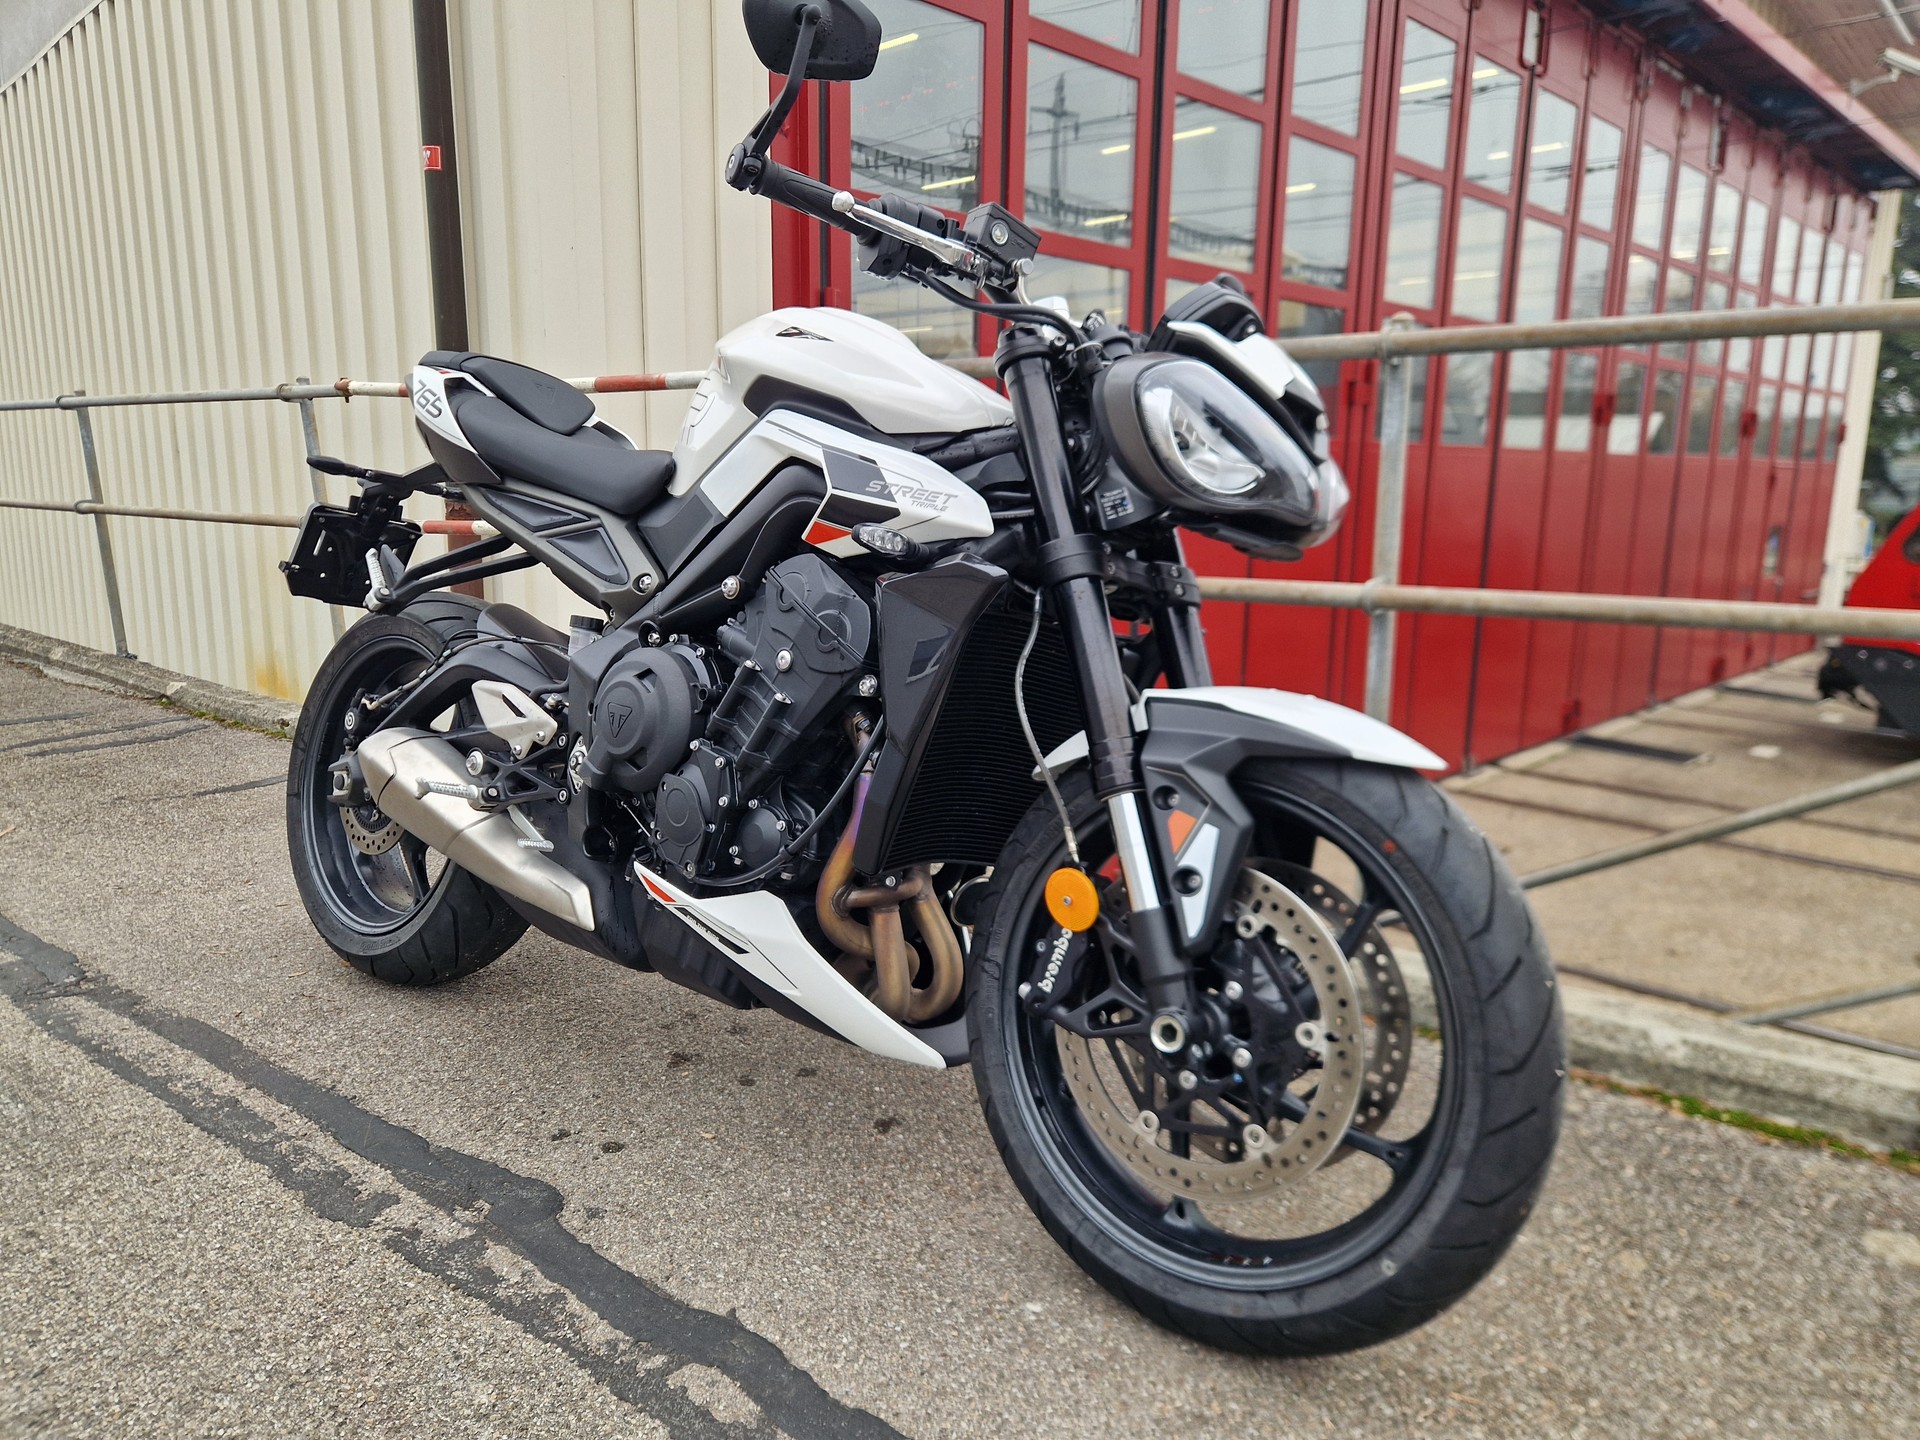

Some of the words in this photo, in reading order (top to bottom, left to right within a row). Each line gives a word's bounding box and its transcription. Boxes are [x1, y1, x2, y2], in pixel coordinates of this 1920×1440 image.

[414, 379, 443, 418] 765
[865, 480, 959, 505] STREET
[911, 500, 950, 512] TRIPLE
[1037, 927, 1074, 994] brembo
